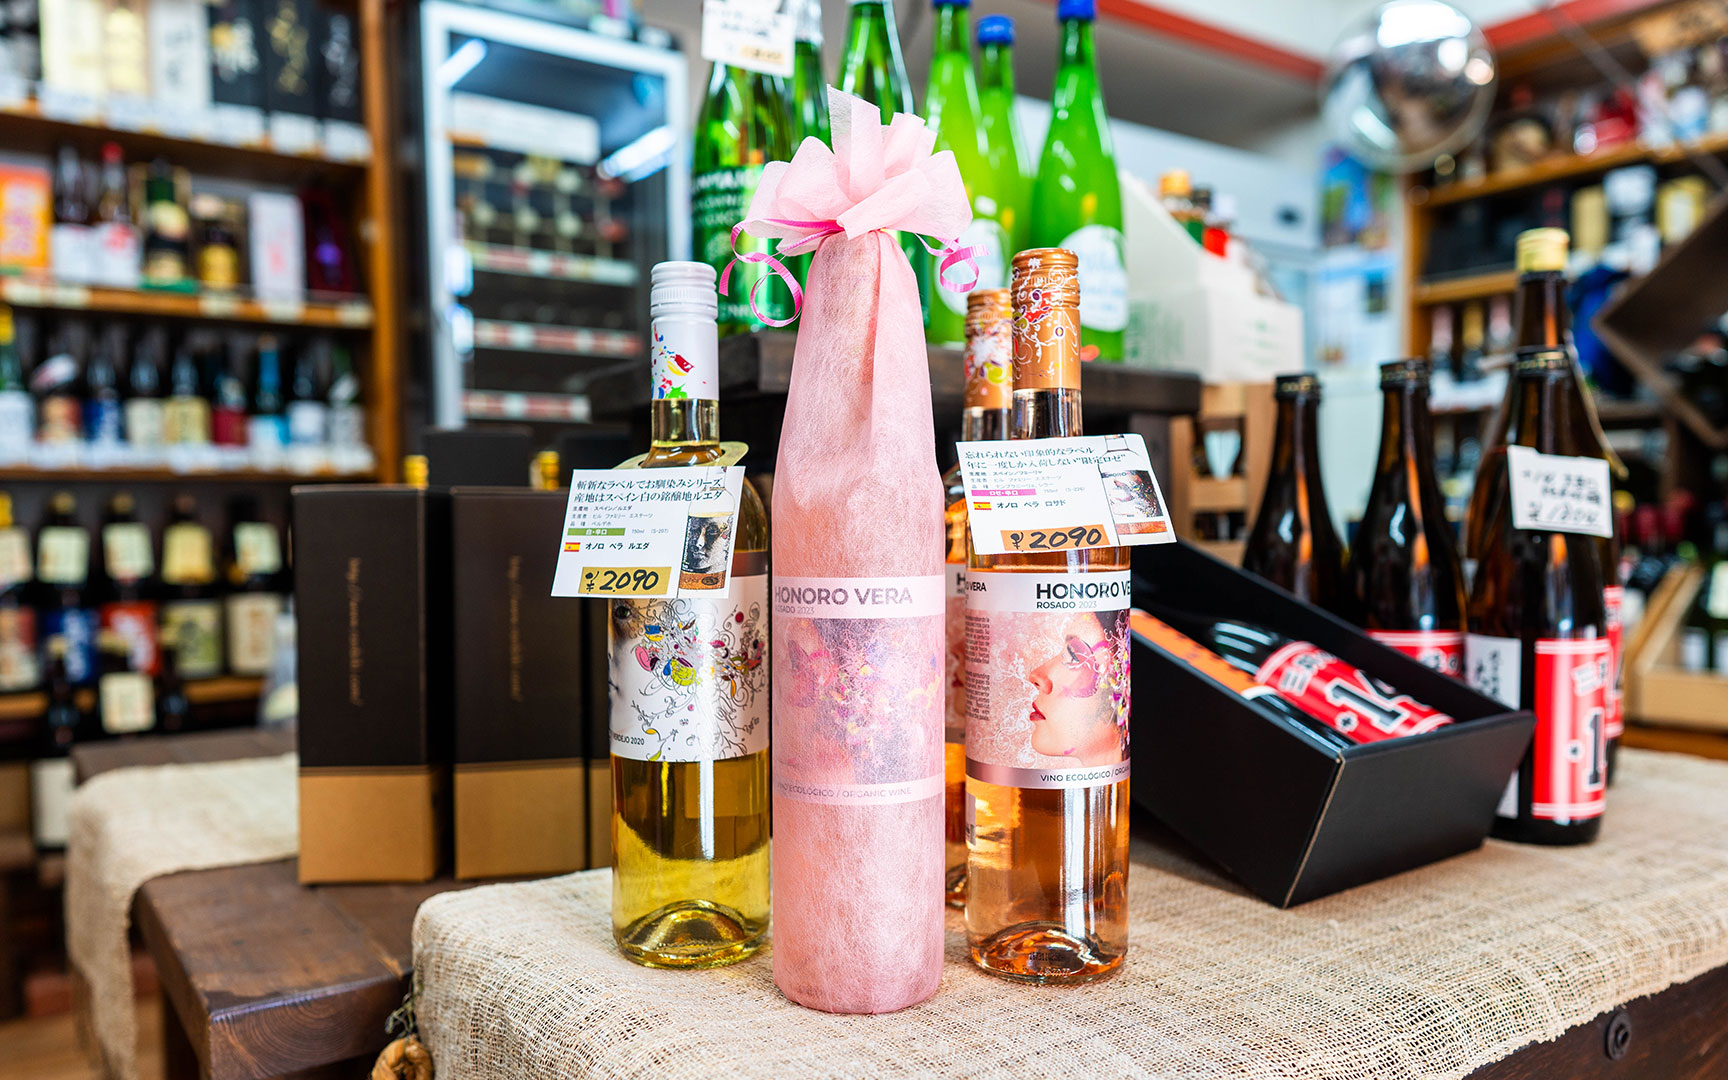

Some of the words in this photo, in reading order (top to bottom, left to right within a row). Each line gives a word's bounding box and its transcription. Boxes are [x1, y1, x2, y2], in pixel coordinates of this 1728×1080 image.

[965, 447, 1094, 459] 忘れられない印象的なラベル
[576, 478, 722, 491] 斬新なラベルでお馴染みシリーズ
[573, 490, 724, 503] 産地はスペイン白の銘醸地ルエダ
[1045, 499, 1066, 507] ロサド
[628, 542, 650, 550] ルエダ
[775, 586, 849, 605] HONORO
[854, 586, 913, 605] VERA
[1036, 581, 1120, 600] HONORO
[797, 606, 815, 615] 2023
[1036, 601, 1076, 609] ROSADO
[1079, 601, 1097, 609] 2023
[630, 736, 645, 746] 2020
[1040, 774, 1063, 782] VINO
[1066, 770, 1111, 782] ECOLÓGICO
[842, 788, 886, 798] ORGANIC
[888, 786, 912, 797] WINE
